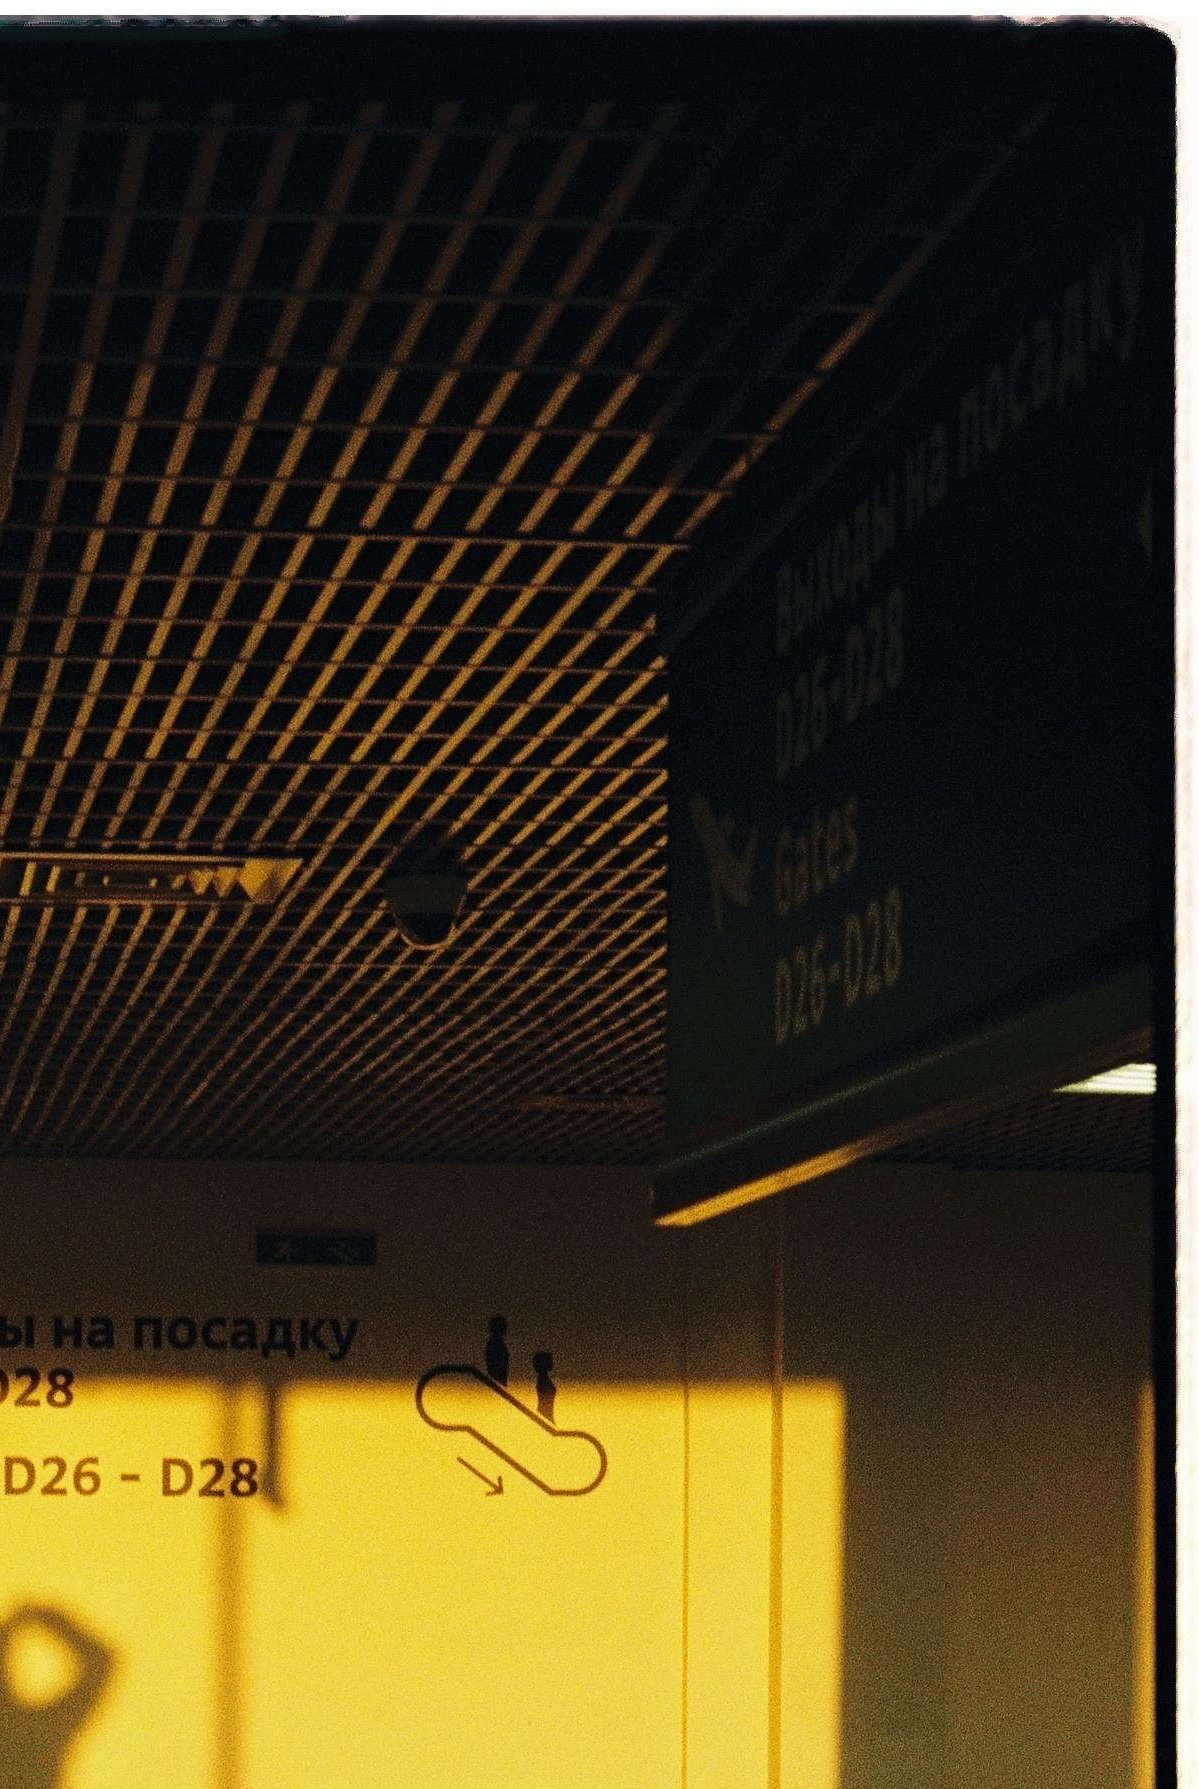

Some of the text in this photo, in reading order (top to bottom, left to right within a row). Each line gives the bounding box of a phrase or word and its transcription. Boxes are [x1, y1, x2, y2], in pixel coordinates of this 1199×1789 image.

[775, 220, 1145, 655] Выходы на посадку
[773, 795, 858, 918] Gates
[53, 1316, 114, 1349] на
[132, 1316, 359, 1360] посадку
[3, 1455, 101, 1496] D26
[159, 1456, 258, 1497] D28
